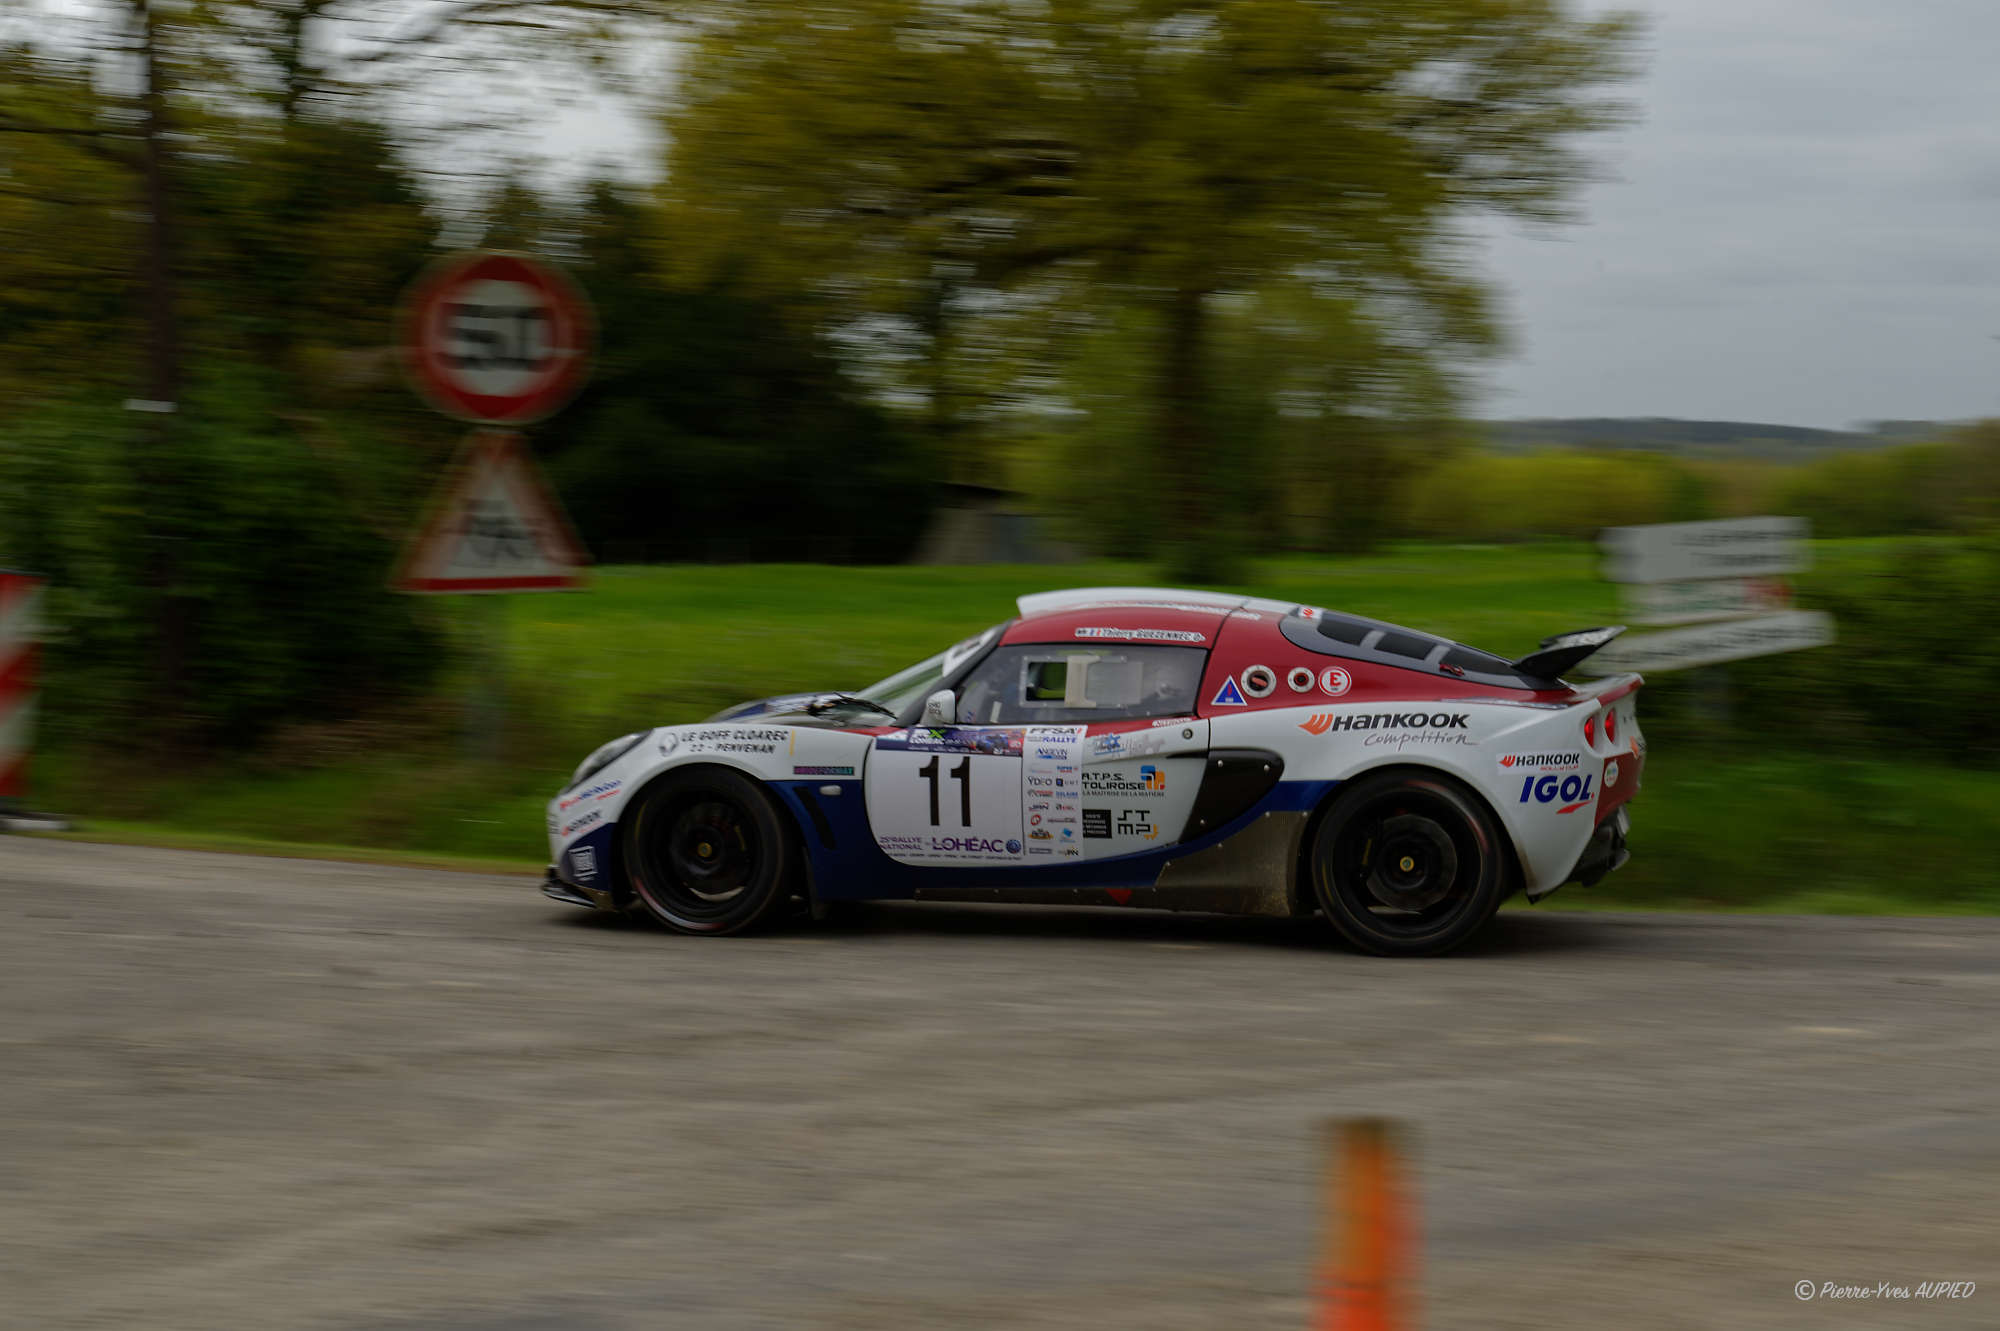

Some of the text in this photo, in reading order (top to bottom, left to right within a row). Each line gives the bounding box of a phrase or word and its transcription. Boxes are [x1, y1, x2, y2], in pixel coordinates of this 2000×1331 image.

[1329, 671, 1342, 687] E
[919, 755, 972, 827] 11
[1519, 774, 1593, 804] IGOL
